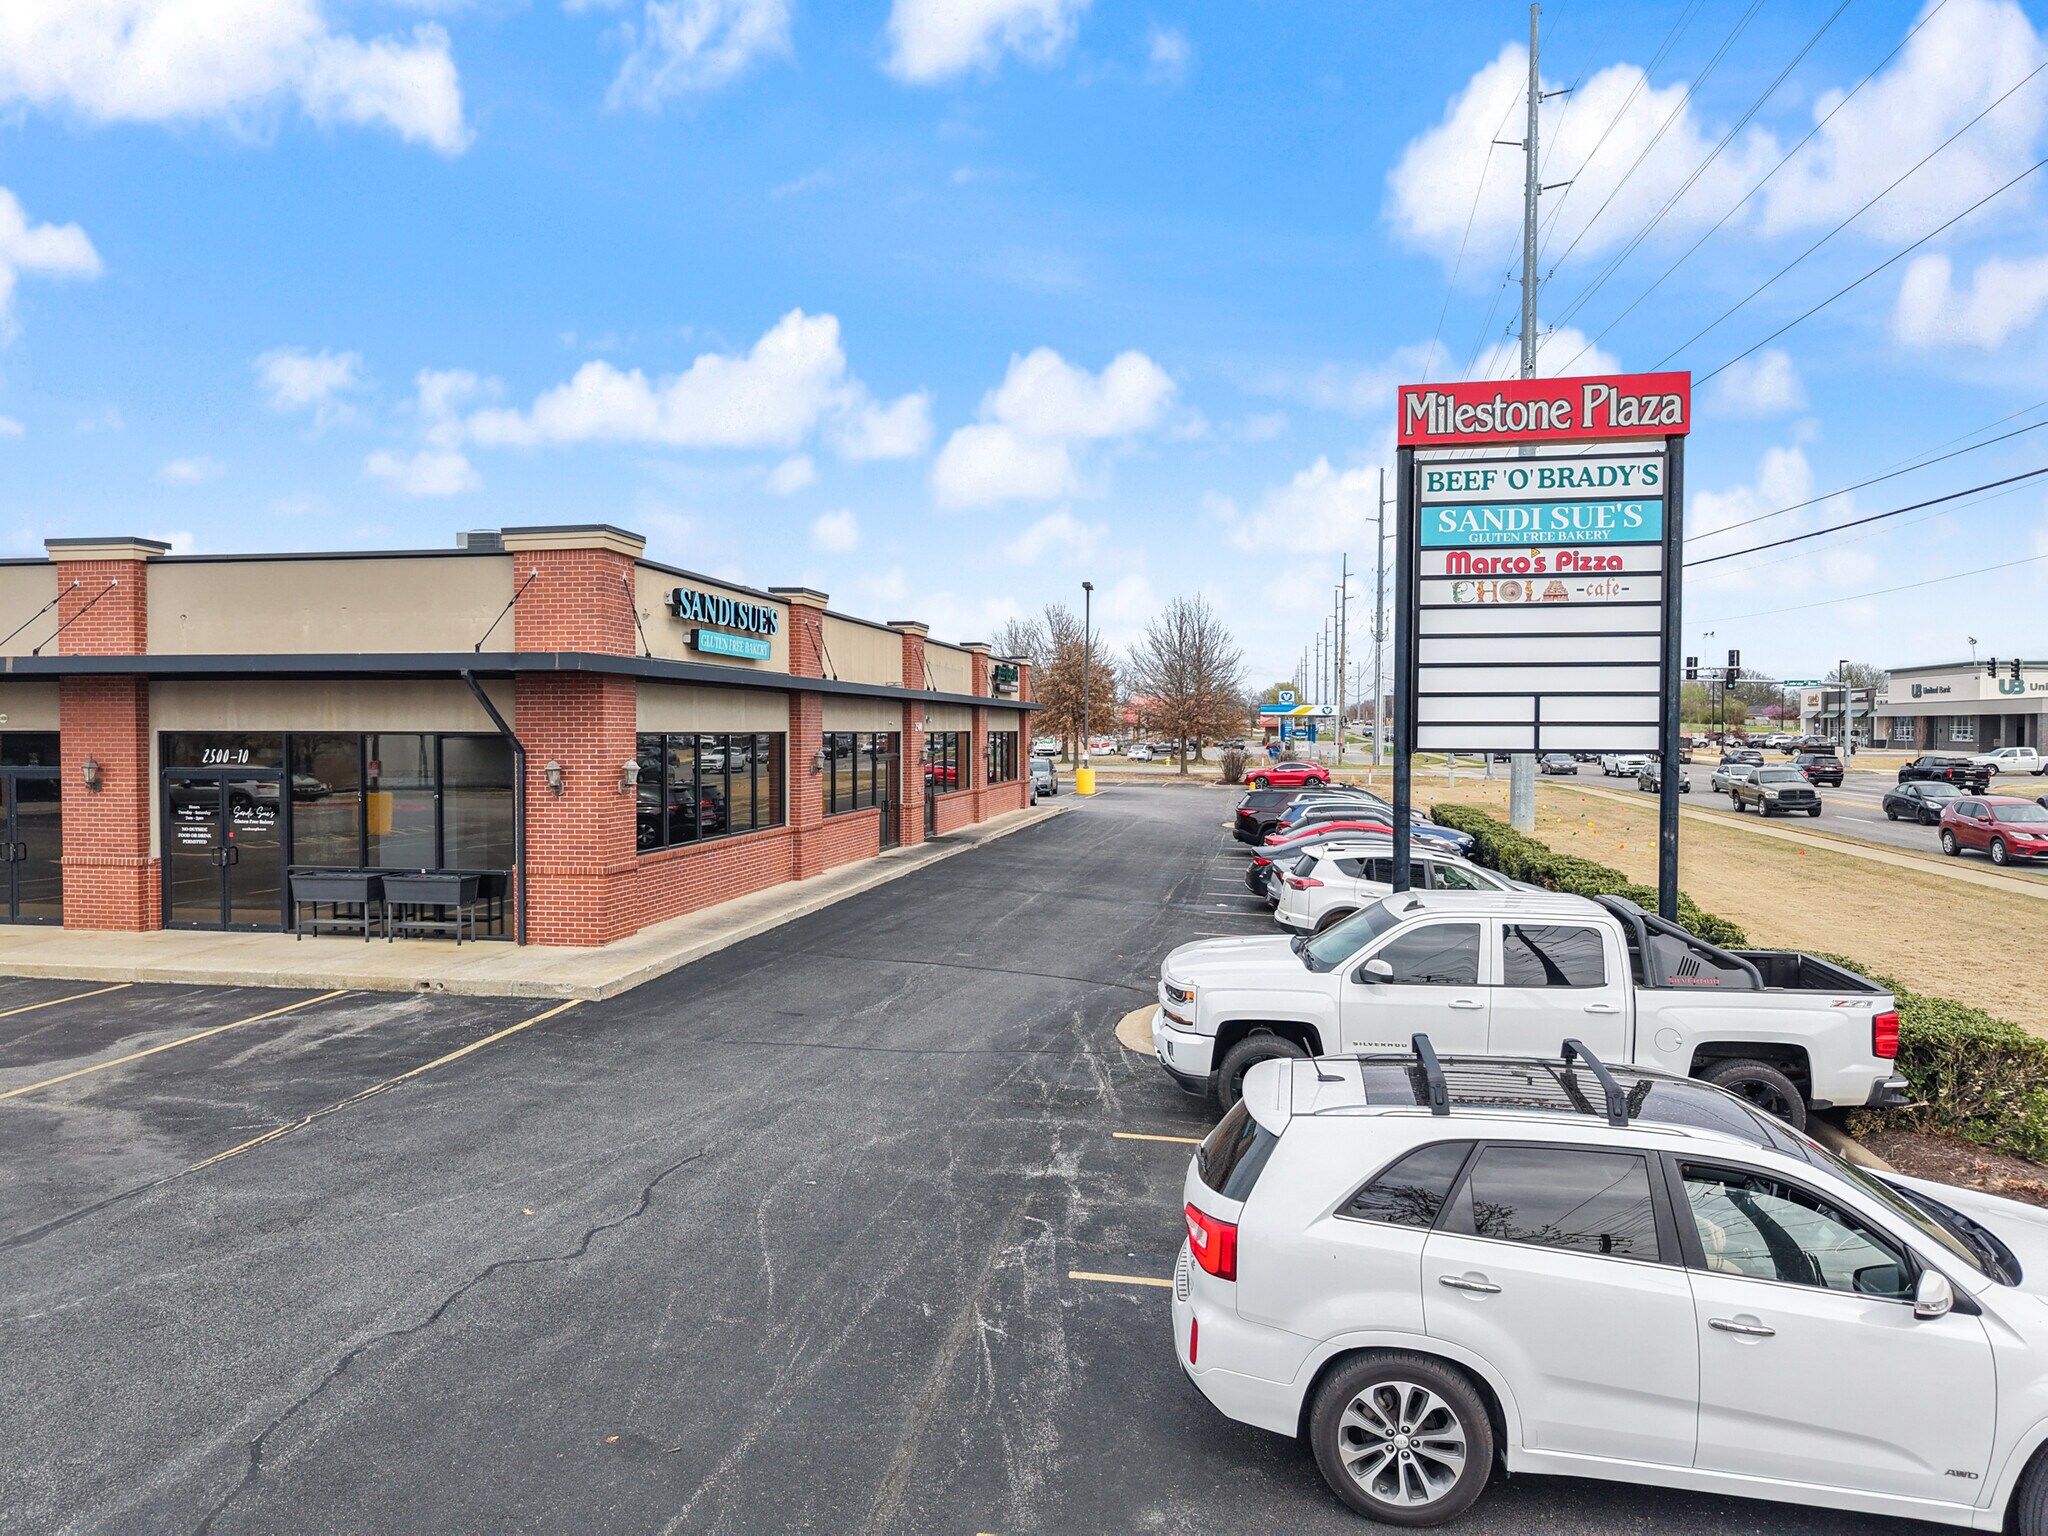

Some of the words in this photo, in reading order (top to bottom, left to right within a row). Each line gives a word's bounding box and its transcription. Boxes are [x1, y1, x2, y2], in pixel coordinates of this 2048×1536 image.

[1404, 390, 1573, 436] Milestone
[1581, 383, 1683, 429] Plaza
[1427, 469, 1498, 492] BEEF
[1503, 468, 1534, 490] 'O'
[1537, 463, 1659, 489] BRADY'S
[1438, 507, 1543, 533] SANDI
[1550, 503, 1643, 530] SUE'S
[1468, 532, 1520, 543] GLUTEN
[1523, 531, 1555, 541] FREE
[1558, 529, 1611, 541] BAKERY
[1446, 548, 1547, 574] Marco's
[1555, 550, 1623, 571] Pizza
[680, 588, 736, 627] SANDI
[738, 601, 778, 635] SUE'S
[701, 635, 728, 649] GLUTEN
[729, 639, 744, 652] FREE
[745, 642, 768, 656] BAKERY
[202, 749, 249, 763] 2500-10
[1944, 1469, 1979, 1480] AWD
